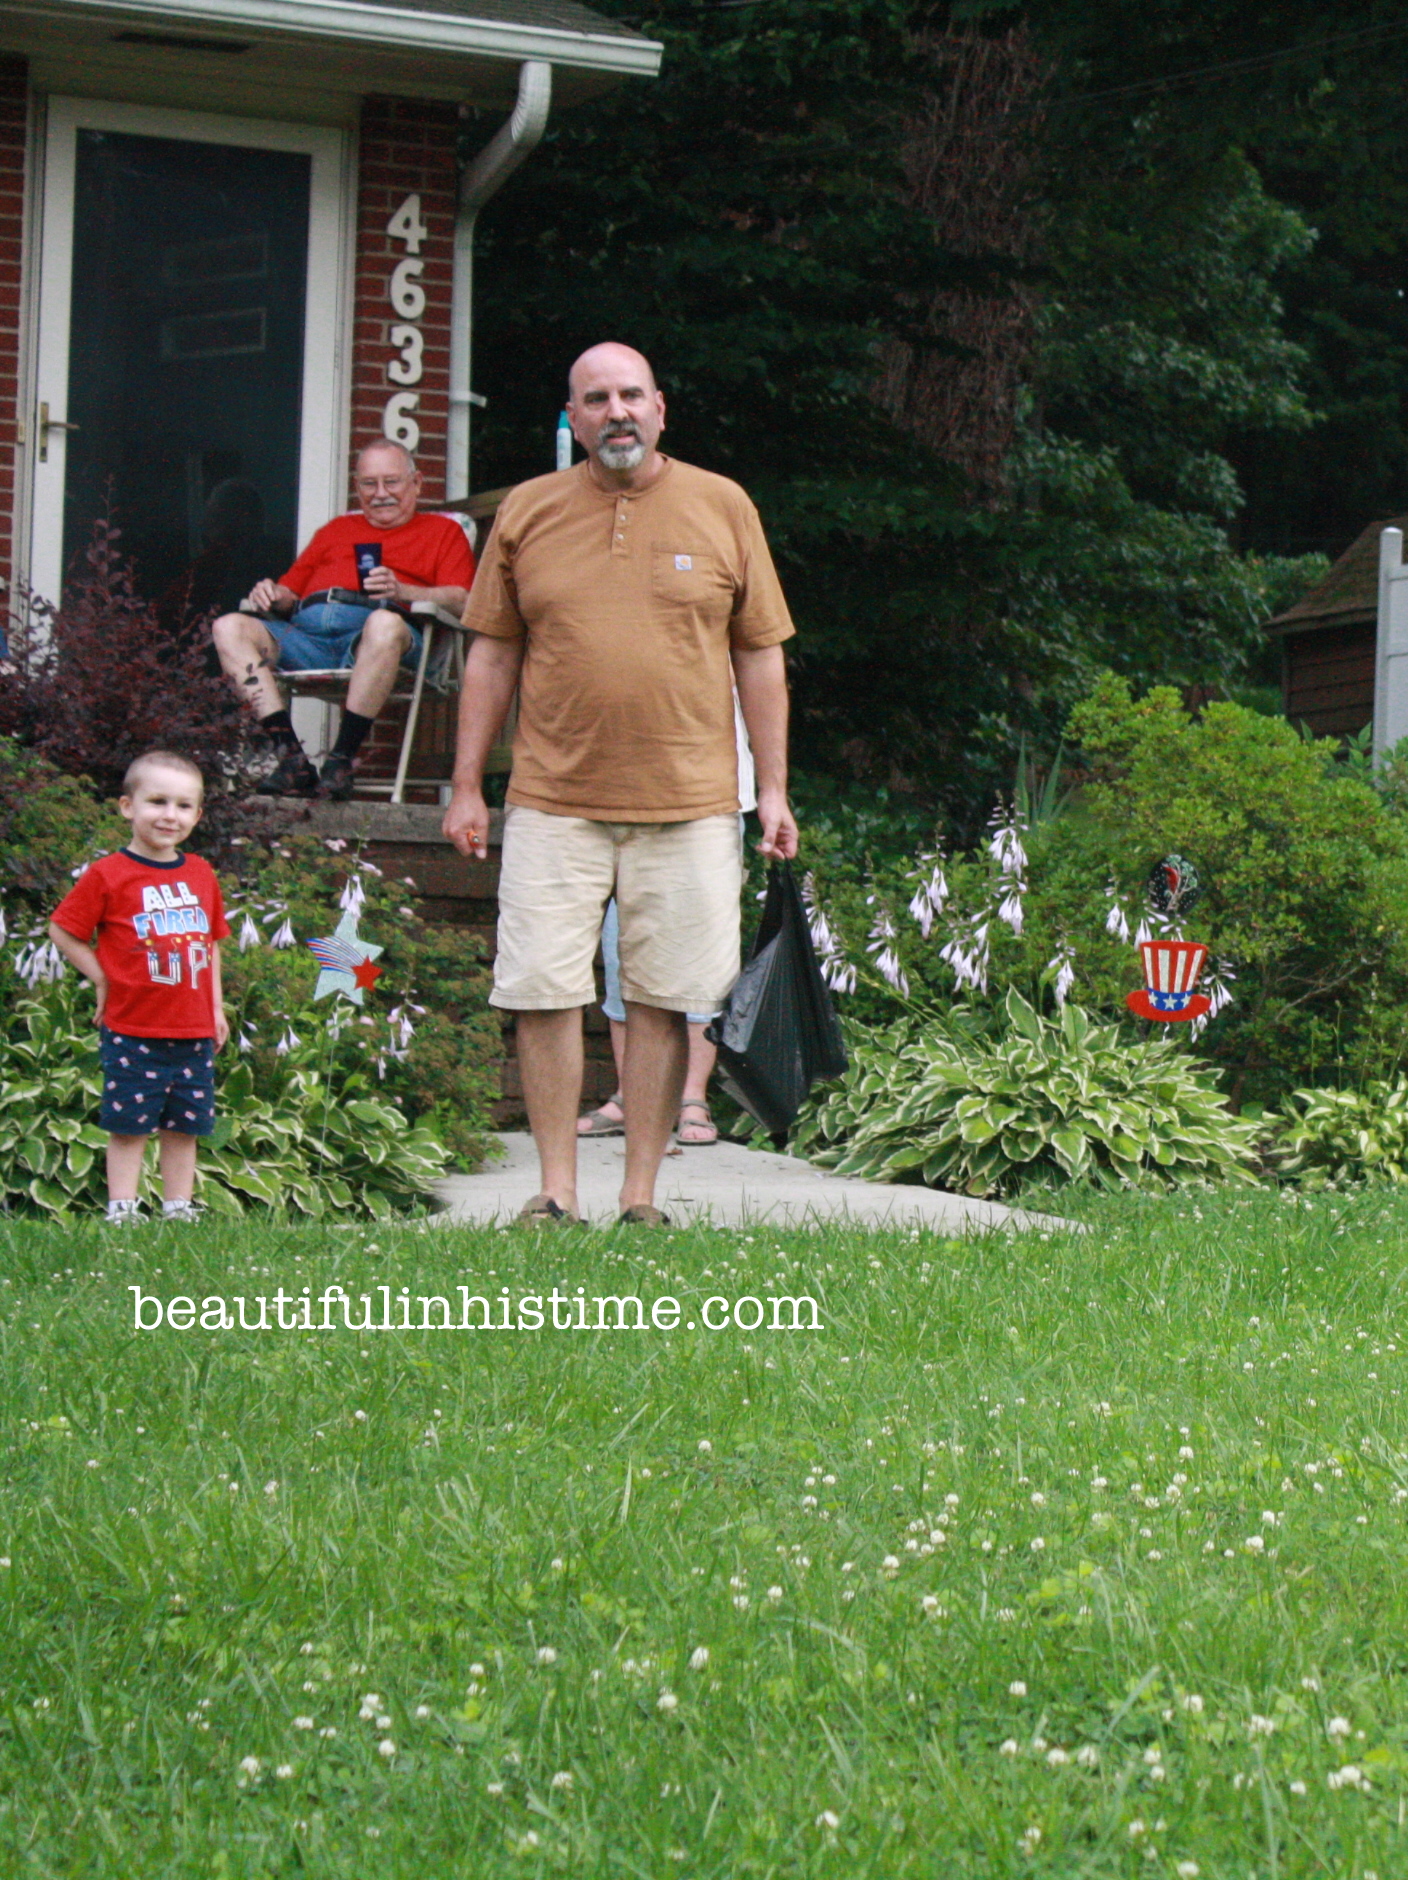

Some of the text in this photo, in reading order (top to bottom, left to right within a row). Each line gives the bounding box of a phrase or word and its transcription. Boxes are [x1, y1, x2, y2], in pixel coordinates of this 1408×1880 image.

[383, 193, 428, 452] 4636
[141, 882, 200, 912] ALL
[132, 907, 209, 939] FIRED
[146, 941, 209, 990] UP
